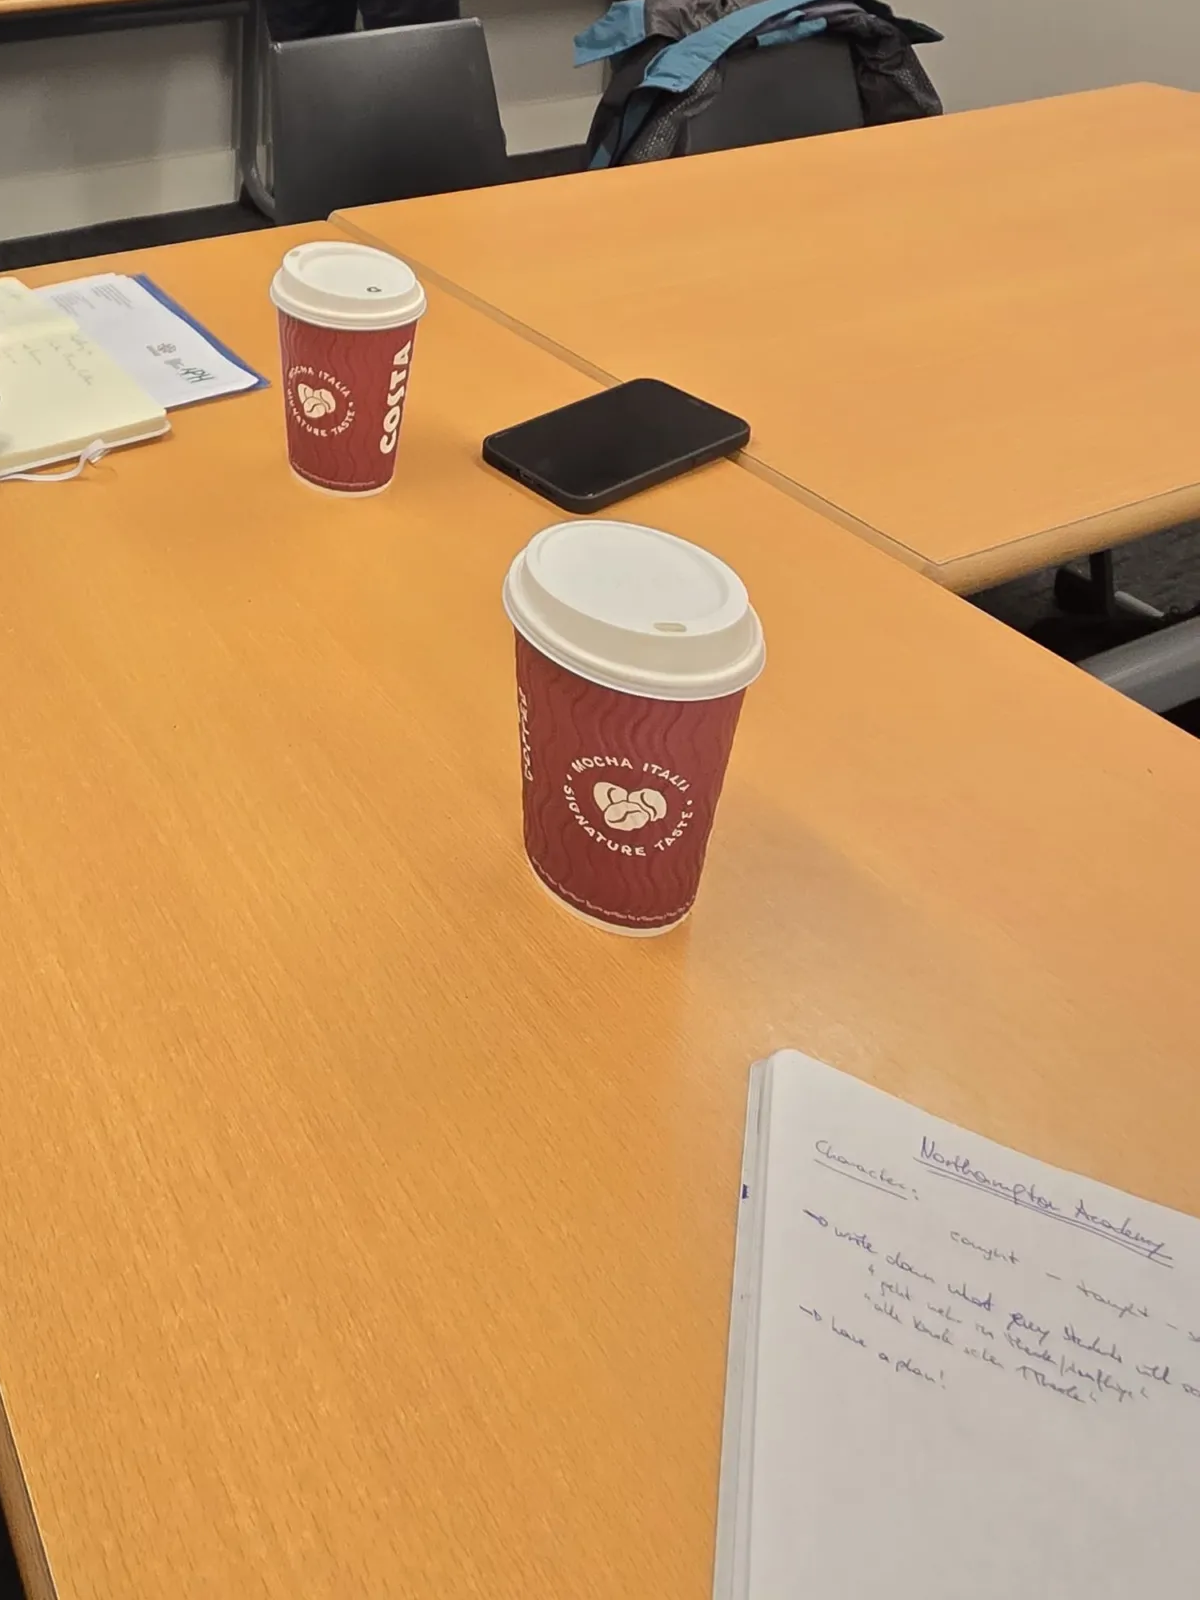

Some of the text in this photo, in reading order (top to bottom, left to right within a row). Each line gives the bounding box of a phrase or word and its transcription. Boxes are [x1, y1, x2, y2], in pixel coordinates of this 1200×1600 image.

[318, 370, 351, 397] ITALIA
[379, 340, 411, 454] COSTA
[330, 410, 355, 437] TASTE
[571, 754, 690, 792] MOCHA ITALIA
[564, 784, 694, 856] SIGNATURE TASTE
[920, 1136, 1166, 1259] Northampton Academy
